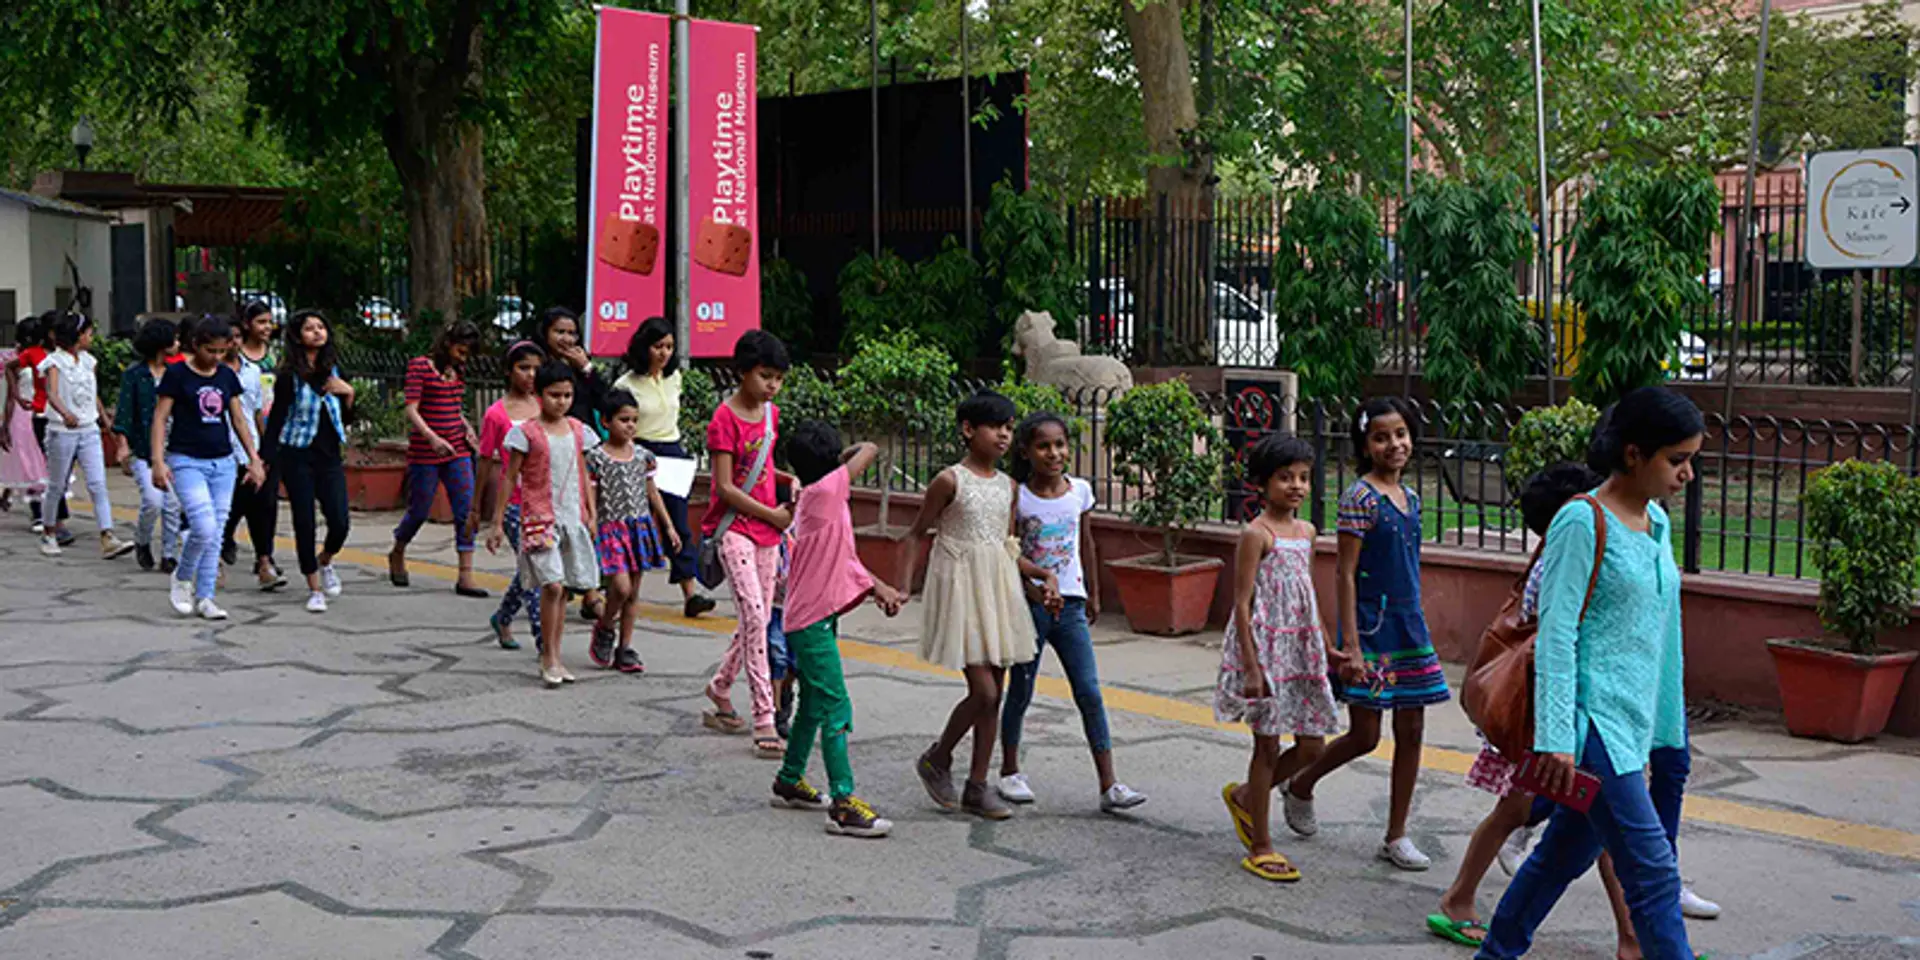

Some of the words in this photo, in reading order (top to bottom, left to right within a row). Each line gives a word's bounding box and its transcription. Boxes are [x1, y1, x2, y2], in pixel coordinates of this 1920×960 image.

[646, 43, 659, 120] Museum
[735, 52, 746, 126] Museum
[619, 84, 647, 222] Playtime
[644, 125, 656, 201] National
[713, 92, 736, 225] Playtime
[735, 130, 746, 203] National
[644, 206, 656, 225] at
[735, 209, 747, 228] at
